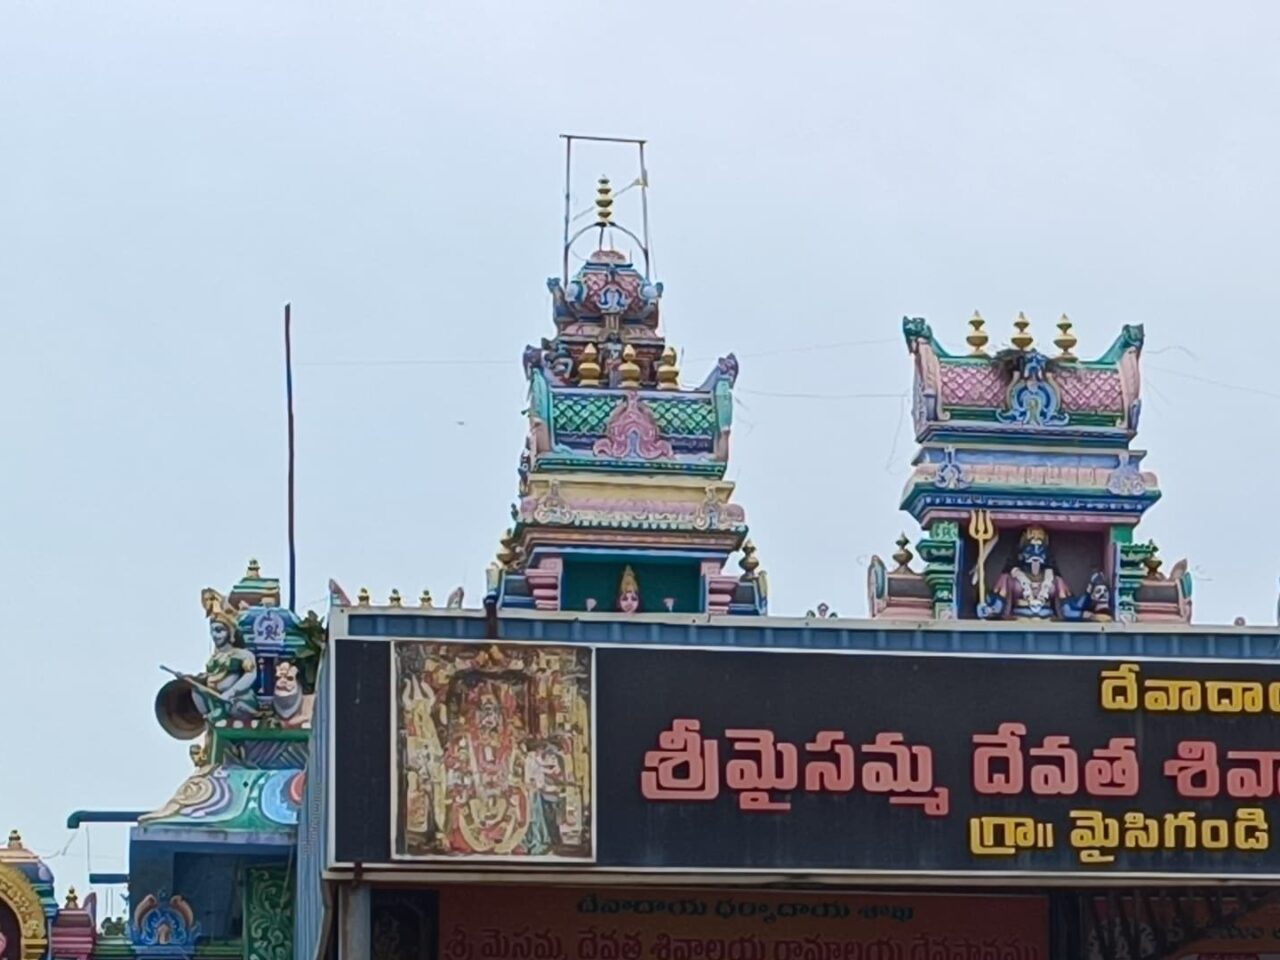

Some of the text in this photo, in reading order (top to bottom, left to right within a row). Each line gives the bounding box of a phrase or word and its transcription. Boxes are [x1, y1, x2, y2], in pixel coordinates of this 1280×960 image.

[972, 722, 1140, 797] దేవత
[1068, 807, 1270, 864] మైసిగండి
[576, 926, 644, 960] దేవత
